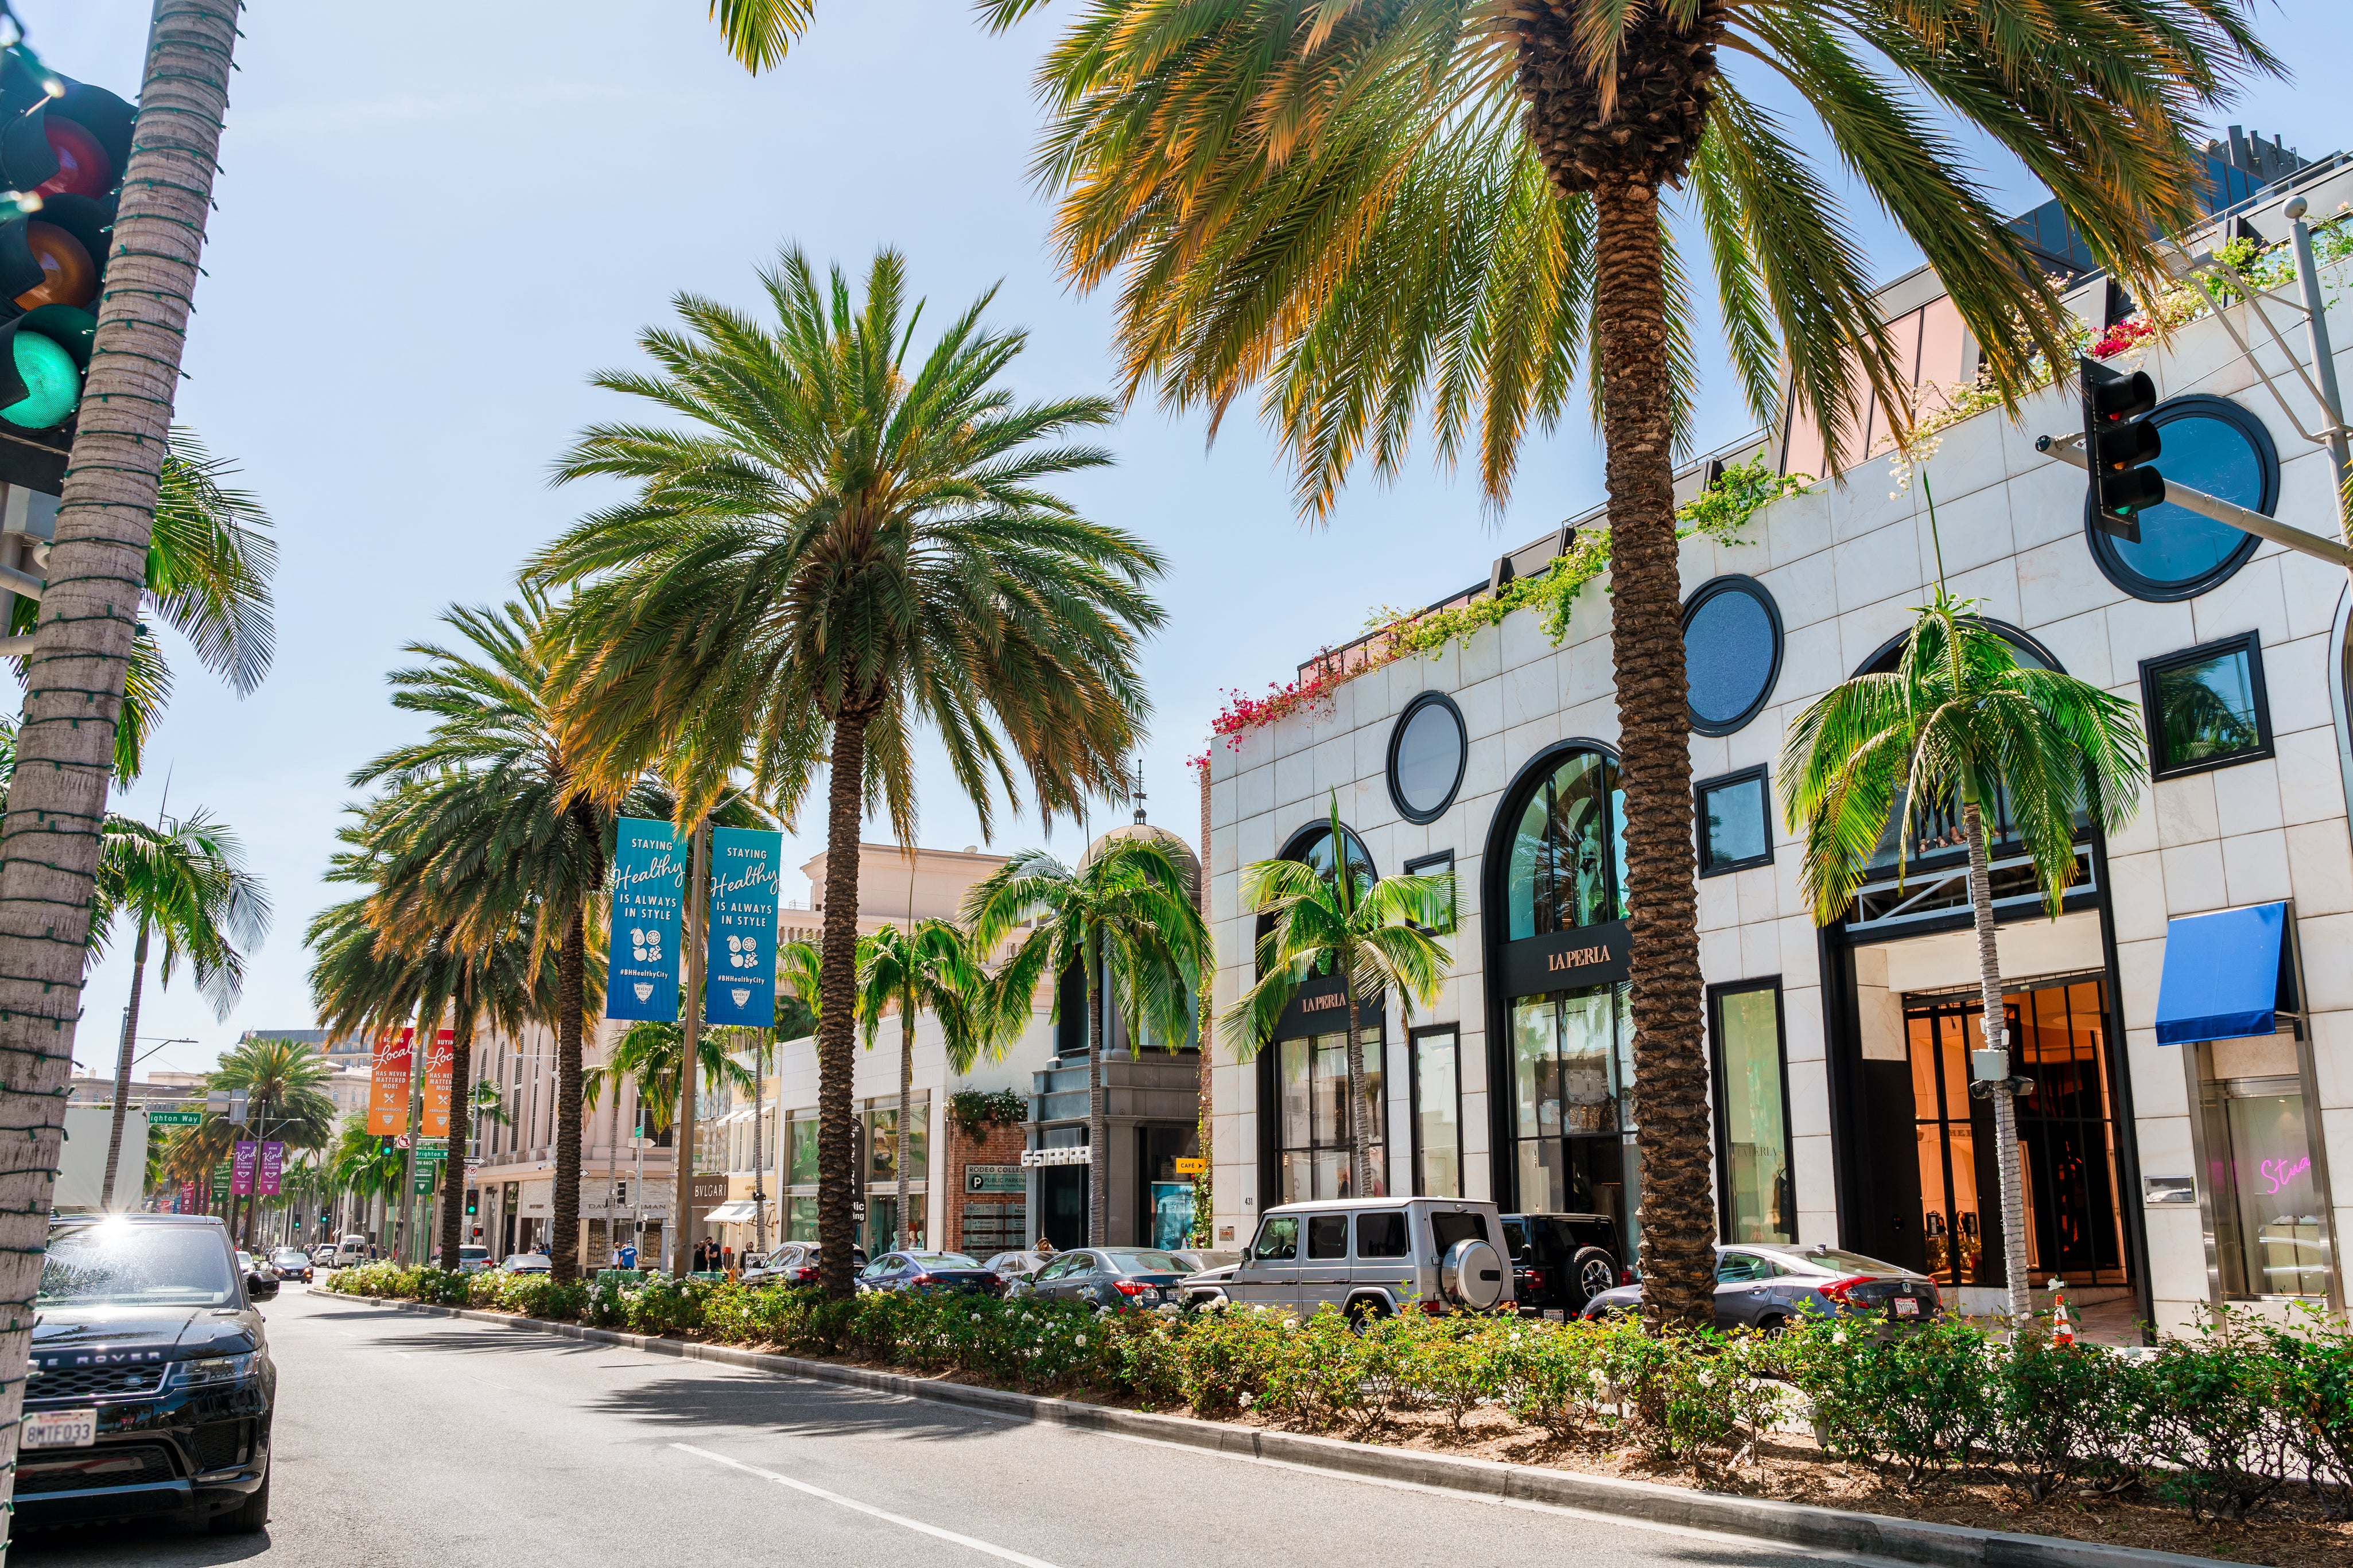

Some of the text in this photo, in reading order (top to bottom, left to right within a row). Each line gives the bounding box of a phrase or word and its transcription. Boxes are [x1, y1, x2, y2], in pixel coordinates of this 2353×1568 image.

[632, 838, 673, 851] STAYING
[727, 847, 767, 859] STAYING
[614, 854, 685, 890] Healthy
[710, 862, 779, 898] Healthy
[620, 893, 677, 908] IS ALWAYS
[624, 908, 671, 920] IN STYLE
[716, 901, 772, 915] IS ALWAYS
[721, 915, 766, 927] IN STYLE
[1548, 944, 1611, 971] LA PERLA
[620, 968, 669, 980] #BHHealthyCity
[717, 975, 765, 985] #BHHealthyCity
[1302, 992, 1347, 1013] LA PERLA
[372, 1036, 414, 1071] Local
[182, 1115, 198, 1123] Way
[235, 1146, 257, 1162] Kind
[262, 1147, 284, 1162] Kind
[1021, 1147, 1069, 1167] G-STAR
[974, 1177, 981, 1188] P
[695, 1184, 727, 1197] BVLGARI
[76, 1352, 160, 1364] ROVER
[27, 1423, 90, 1442] 8MTF033
